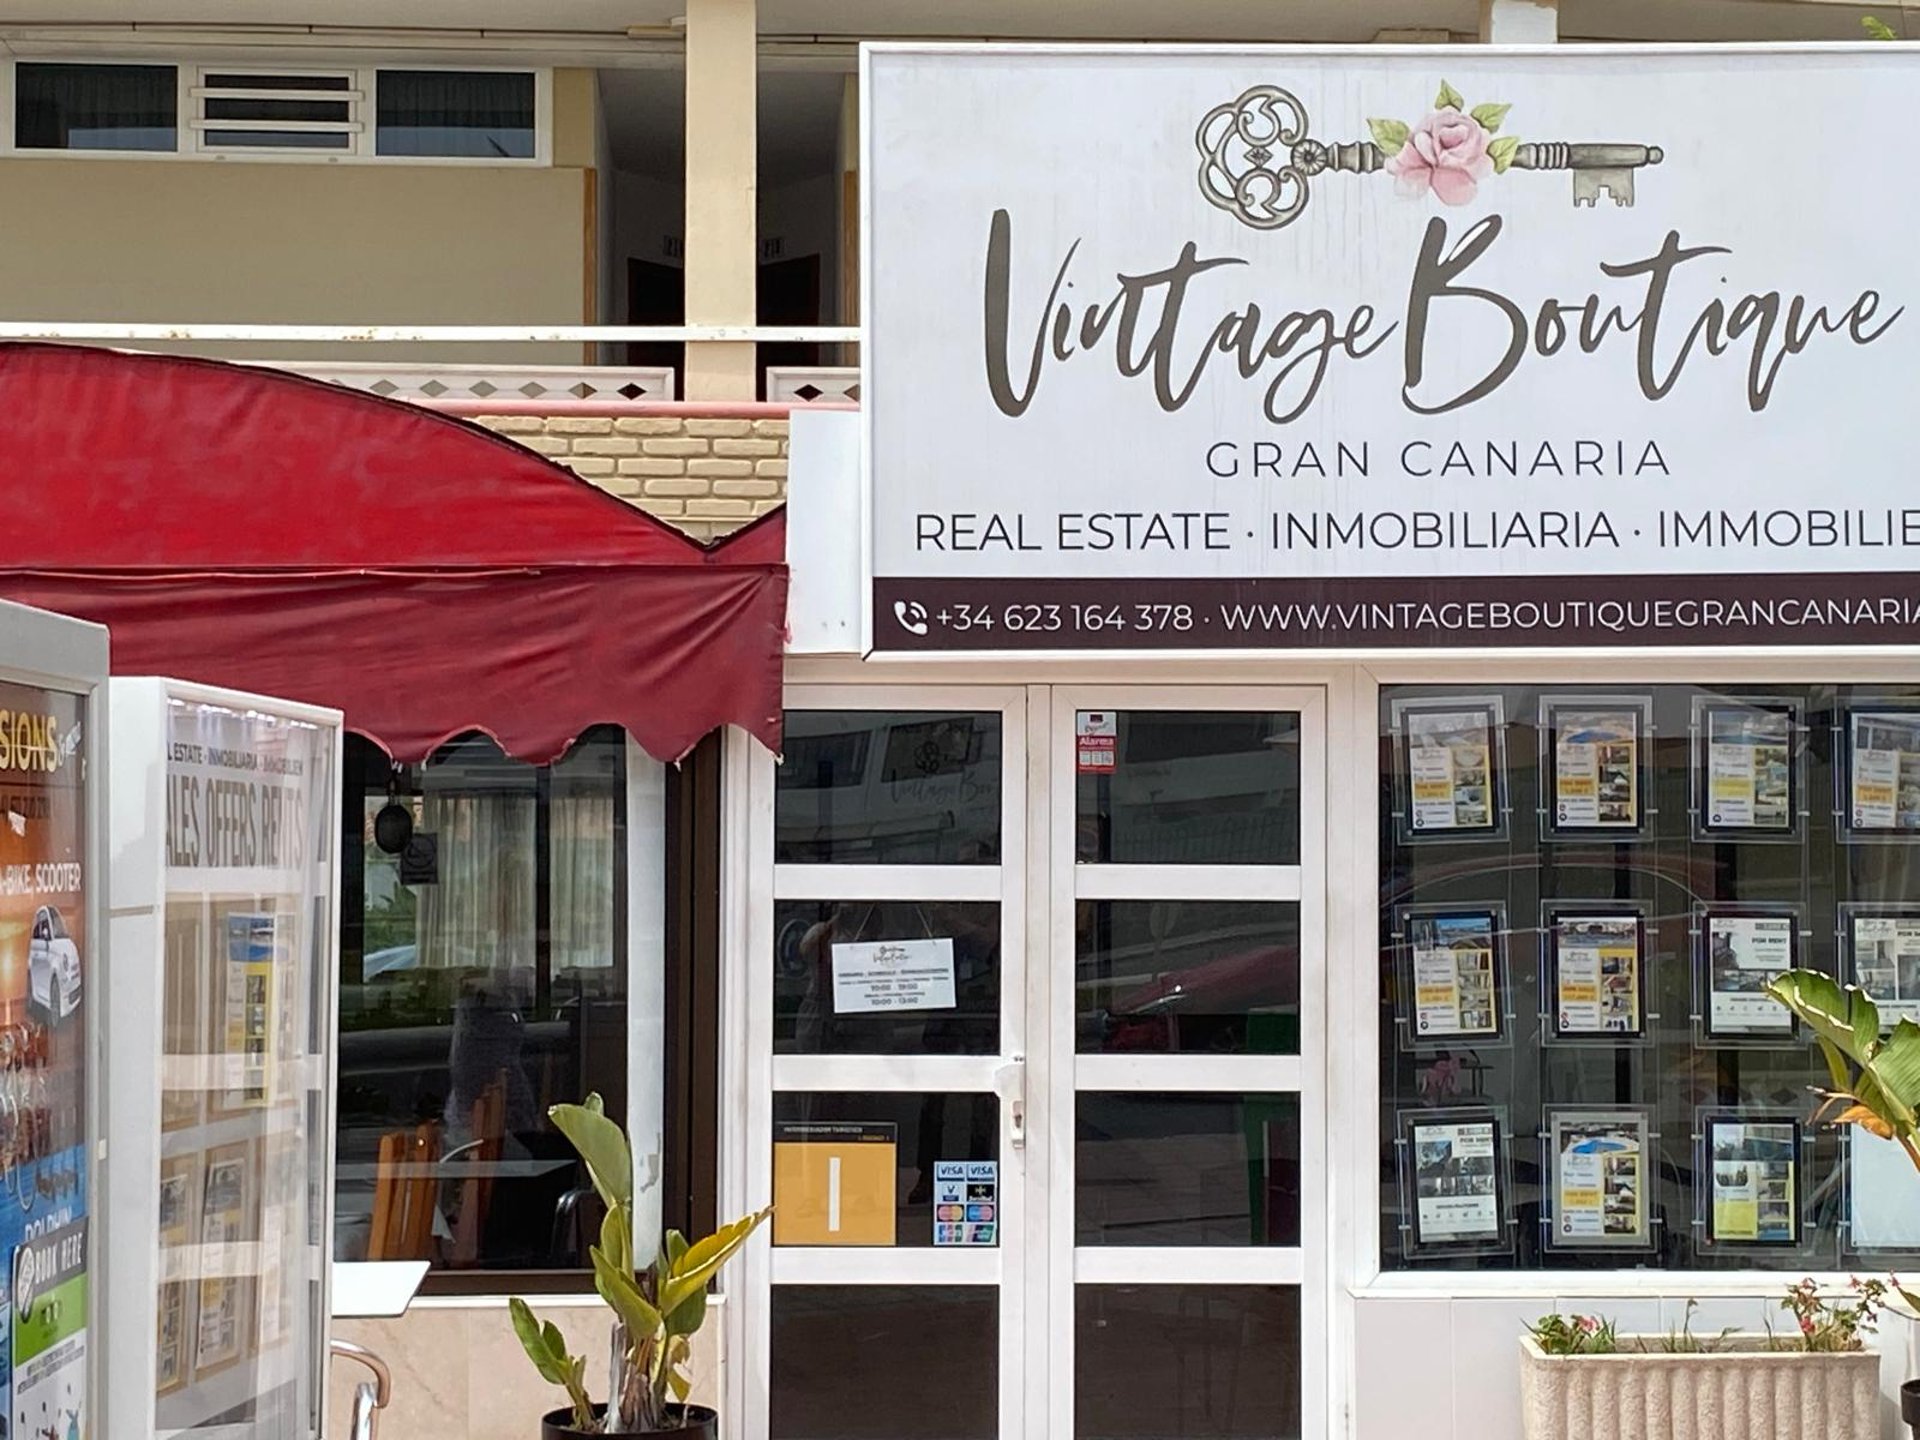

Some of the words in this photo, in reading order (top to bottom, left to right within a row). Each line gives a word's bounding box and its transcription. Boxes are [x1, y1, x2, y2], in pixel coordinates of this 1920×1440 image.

[985, 208, 1399, 425] Vintage
[1401, 213, 1905, 416] Boutique
[1206, 441, 1368, 478] GRAN
[1401, 440, 1670, 477] CANARIA
[917, 513, 1042, 551] REAL
[1058, 512, 1231, 550] ESTATE
[1273, 511, 1620, 549] INMOBILIARIA
[1660, 509, 1920, 547] IMMOBILIE
[936, 604, 995, 631] +34
[1004, 604, 1061, 631] 623
[1071, 604, 1126, 631] 164
[1135, 604, 1193, 631] 378
[174, 742, 202, 764] ESTATE
[206, 778, 256, 868] OFFERS
[35, 862, 81, 893] SCOOTER
[941, 1166, 963, 1175] VISA
[971, 1166, 993, 1175] VISA
